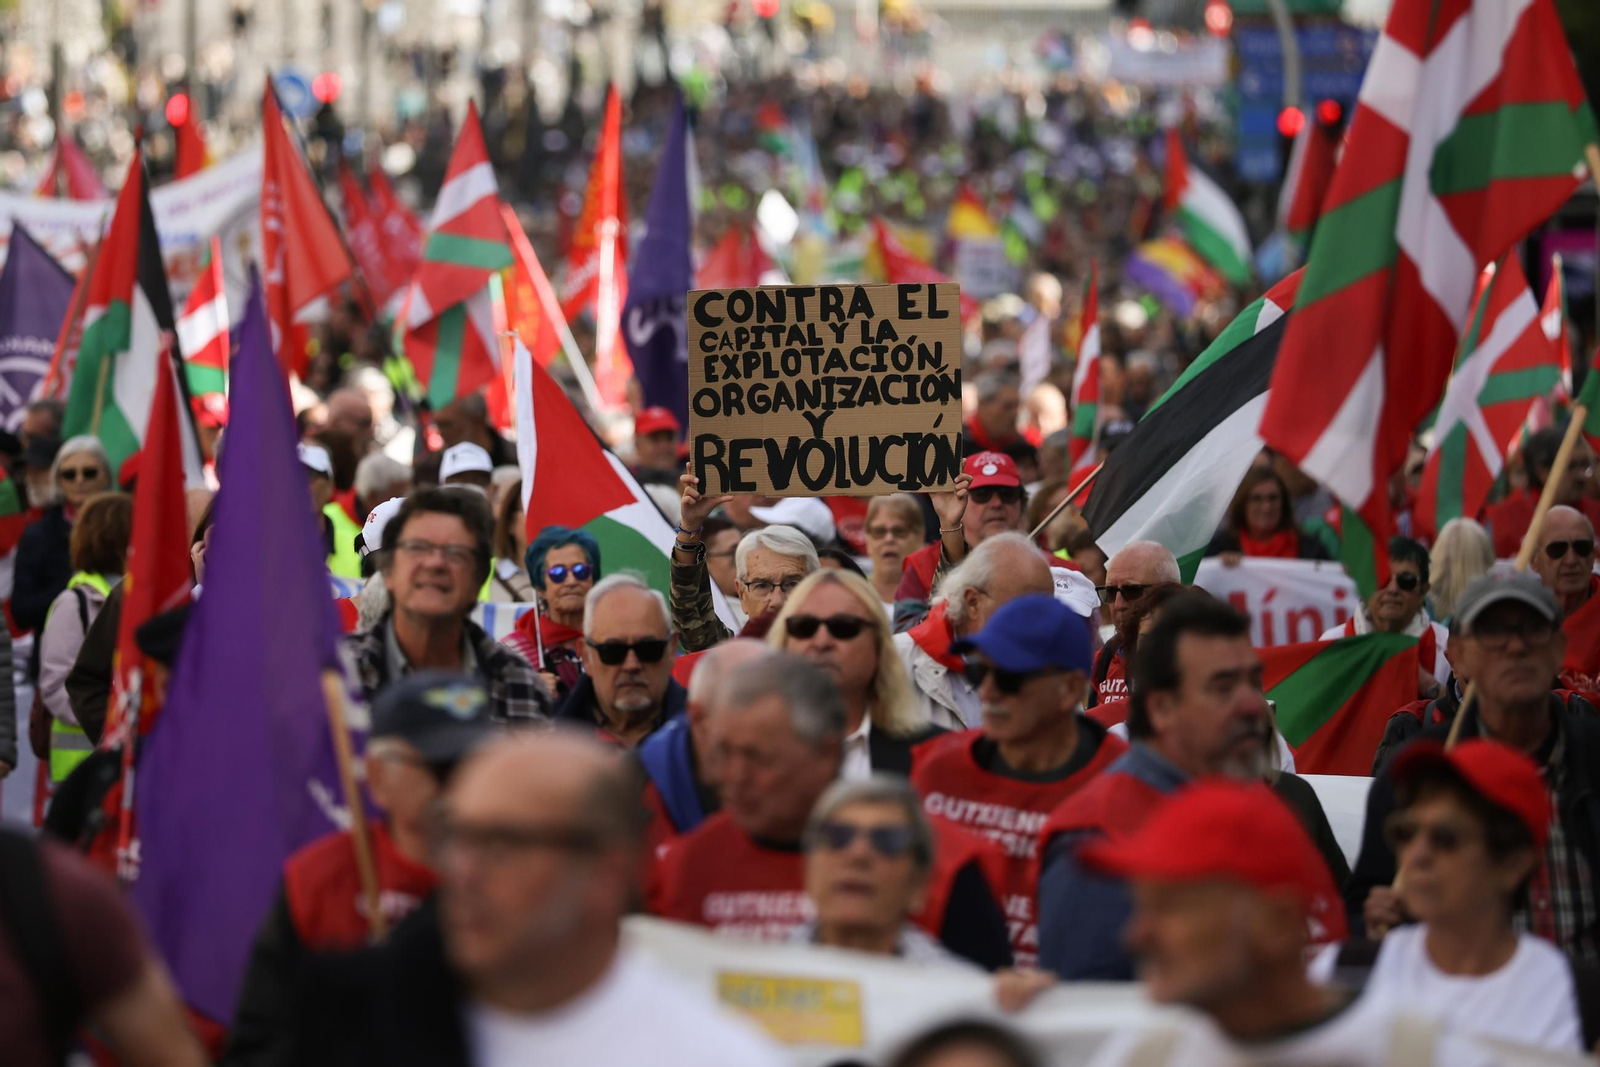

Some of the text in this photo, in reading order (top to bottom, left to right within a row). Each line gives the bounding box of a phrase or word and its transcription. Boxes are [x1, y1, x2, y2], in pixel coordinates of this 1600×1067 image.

[694, 284, 949, 327] CONTRA EL
[699, 319, 899, 353] CAPITAL Y LA
[704, 335, 943, 383] EXPLOTACIÓN
[692, 364, 961, 417] ORGANIZACIÓN
[802, 410, 834, 438] Y
[694, 413, 962, 495] REVOLUCIÓN
